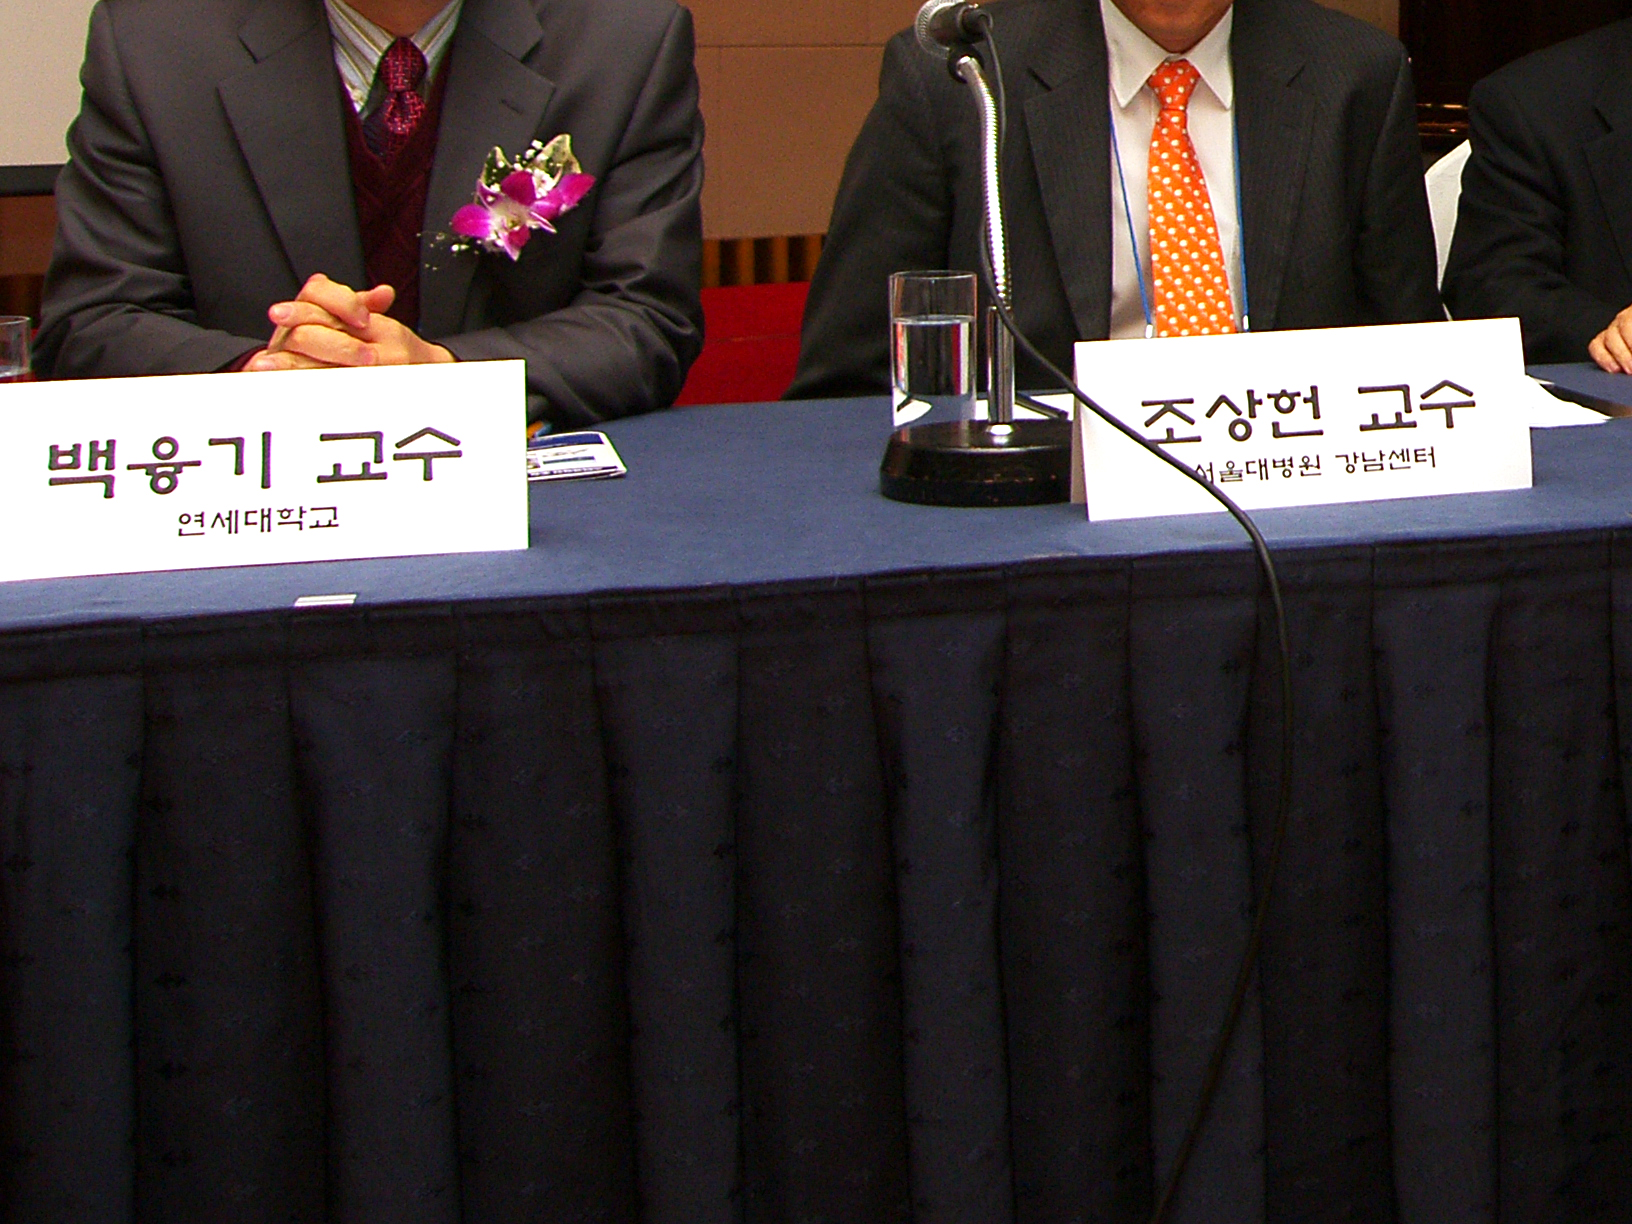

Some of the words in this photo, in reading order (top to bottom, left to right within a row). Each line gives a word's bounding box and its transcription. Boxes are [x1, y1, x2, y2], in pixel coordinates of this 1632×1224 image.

[1141, 385, 1324, 445] 조상헌
[1357, 379, 1476, 432] 교수
[47, 431, 272, 499] 백융기
[316, 426, 463, 484] 교수
[1195, 454, 1322, 484] 서울대병원
[1335, 446, 1436, 474] 강남센터
[178, 505, 339, 537] 연세대학교
